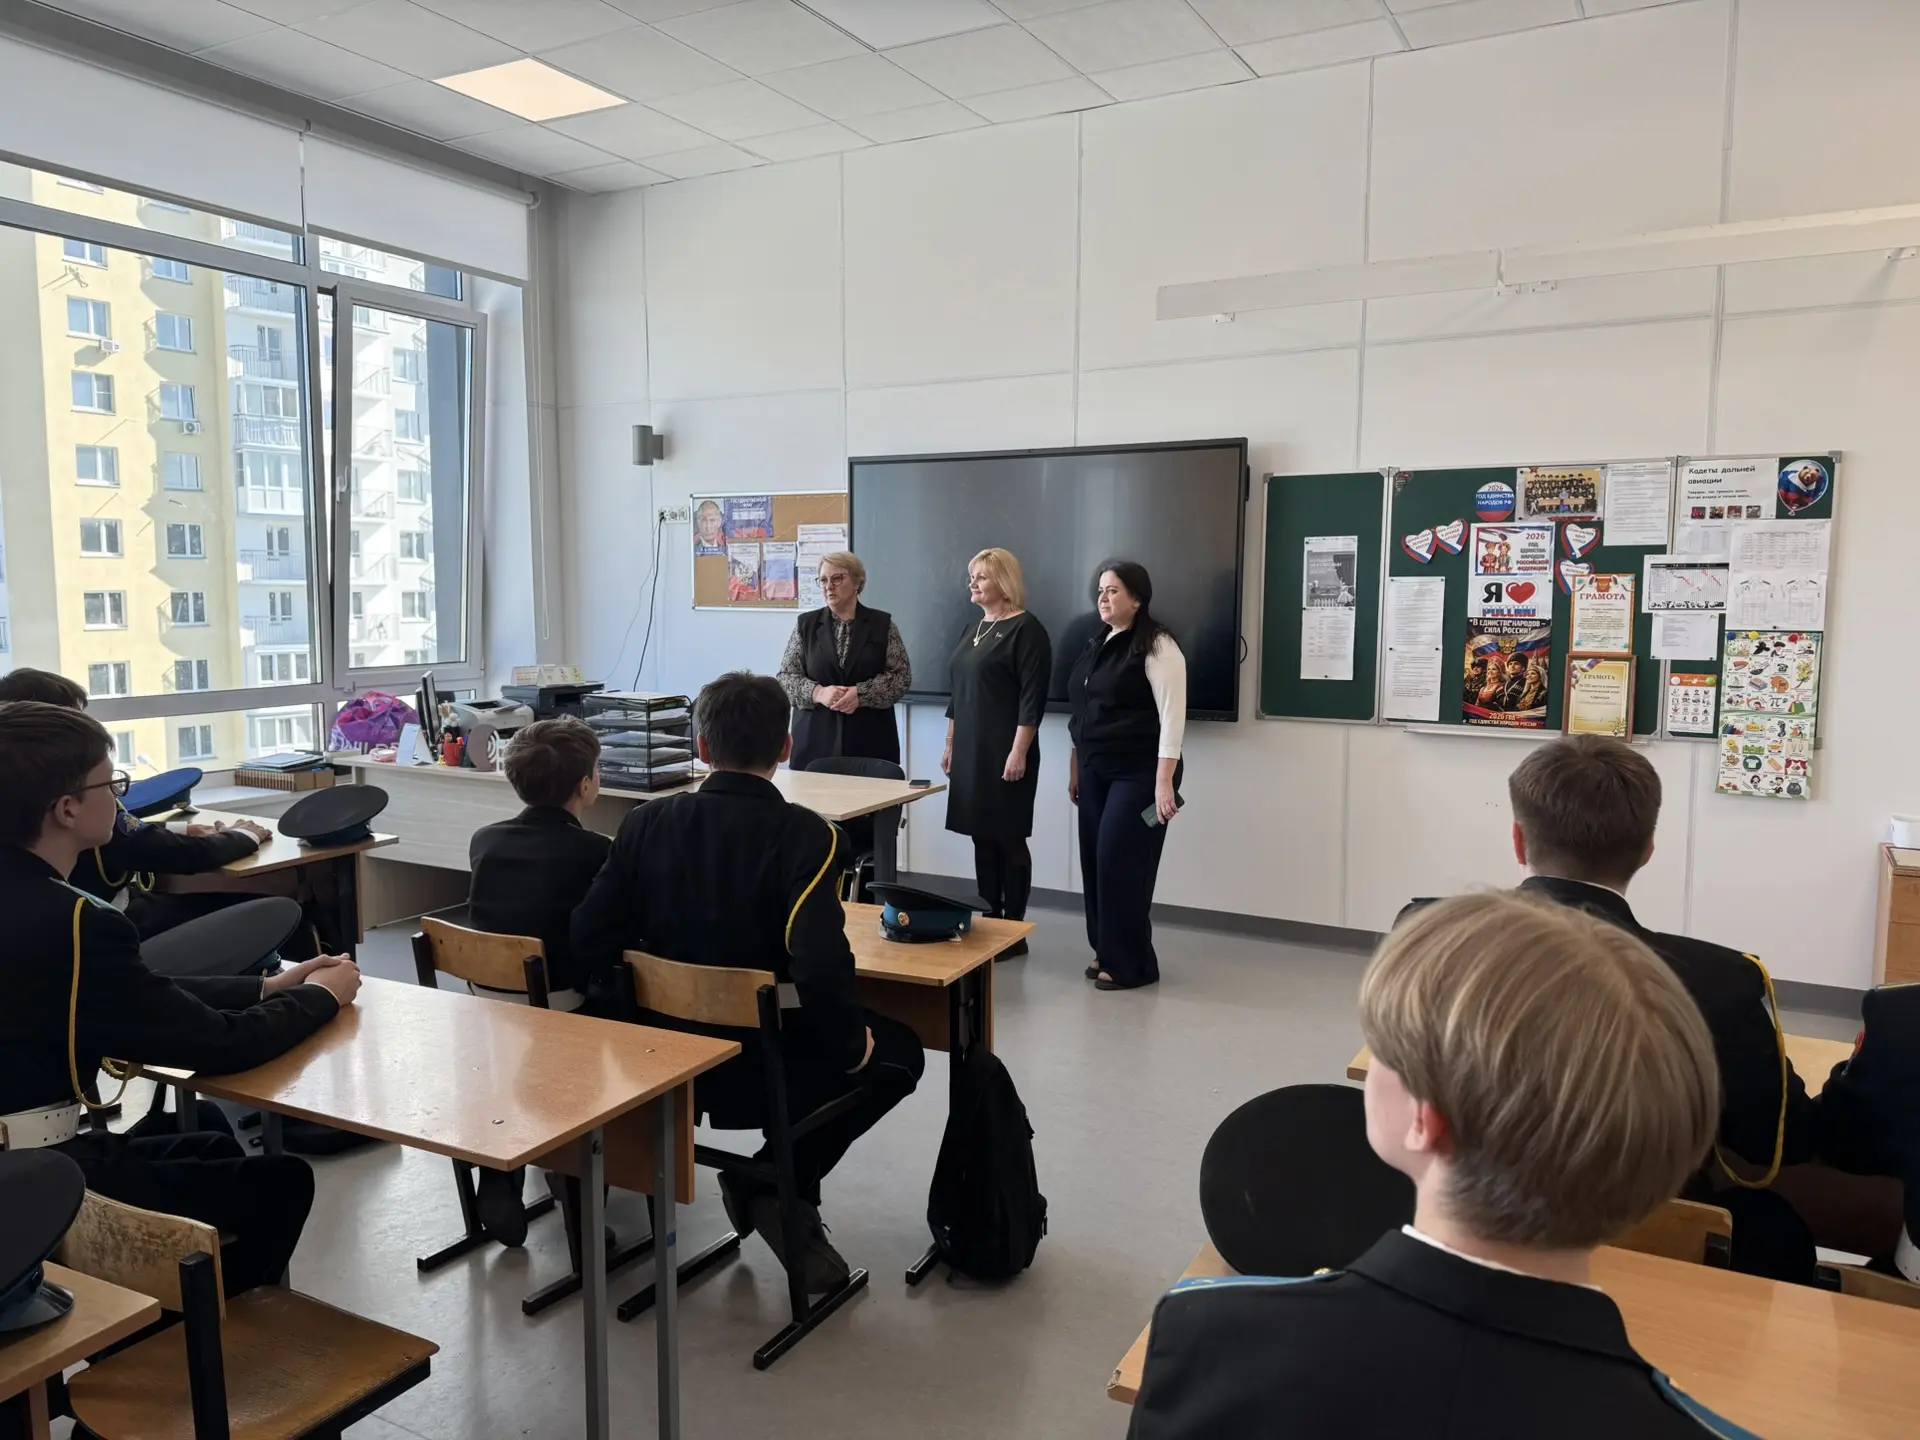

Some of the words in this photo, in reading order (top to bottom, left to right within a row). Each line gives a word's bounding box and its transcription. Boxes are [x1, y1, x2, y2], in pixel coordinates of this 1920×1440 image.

[1688, 467, 1718, 475] Кадеты
[1721, 465, 1756, 474] дальней
[1688, 477, 1723, 485] авиации
[1482, 582, 1503, 603] Я
[1484, 626, 1501, 634] СИЛА
